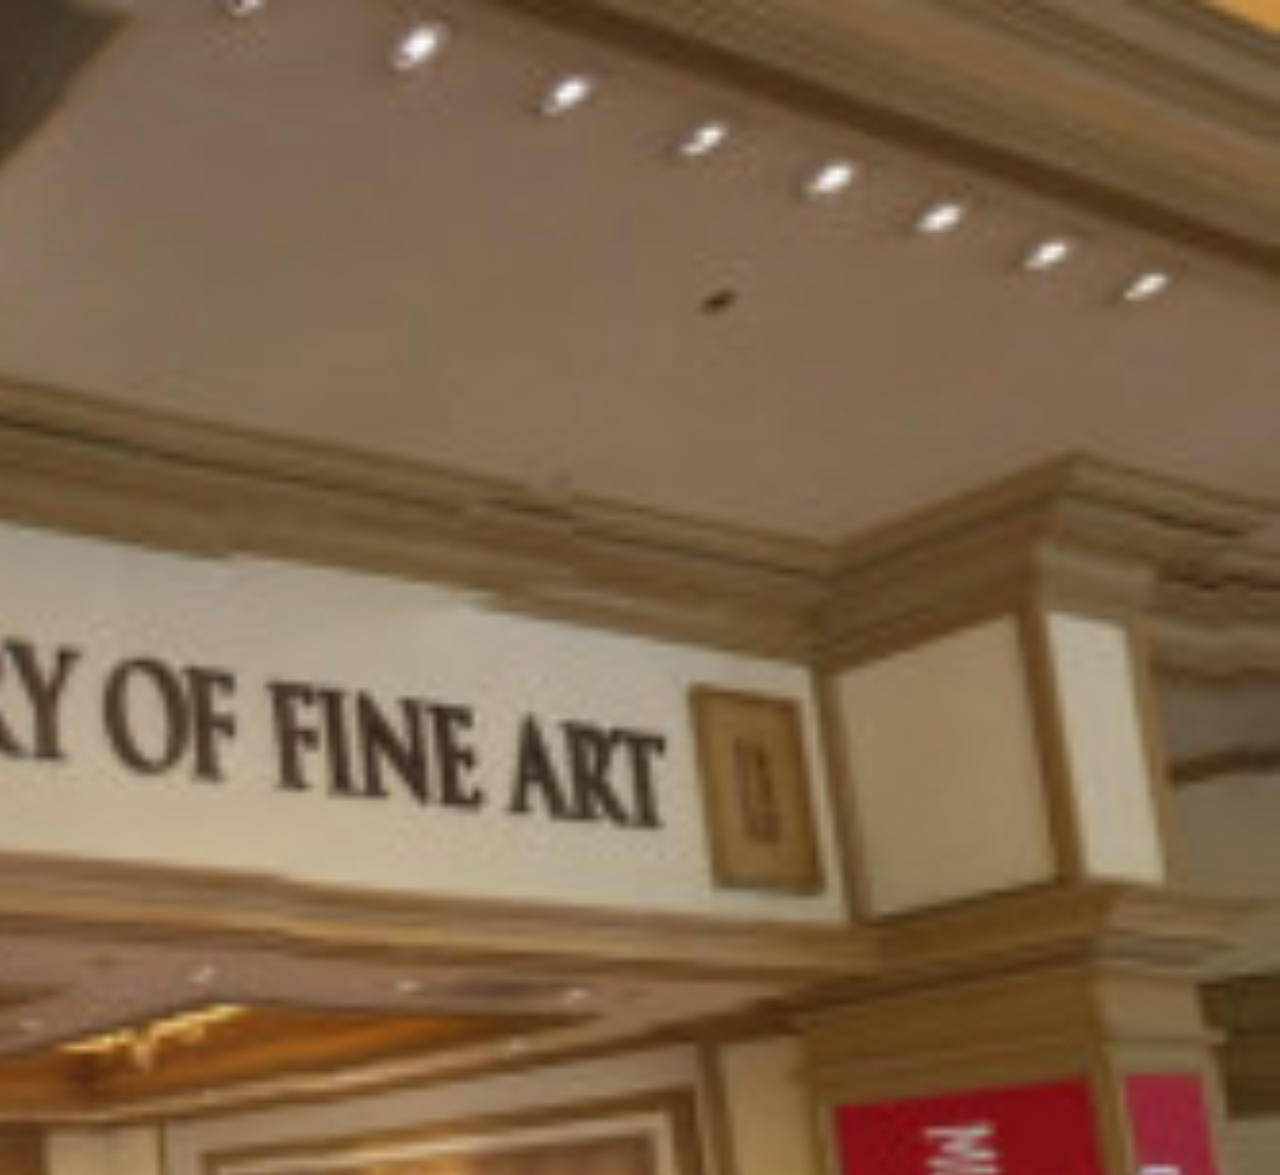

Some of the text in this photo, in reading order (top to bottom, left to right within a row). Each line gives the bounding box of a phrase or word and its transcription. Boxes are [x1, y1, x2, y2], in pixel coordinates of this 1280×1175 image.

[102, 655, 237, 784] OF
[266, 680, 483, 815] FINE
[506, 712, 667, 830] ART
